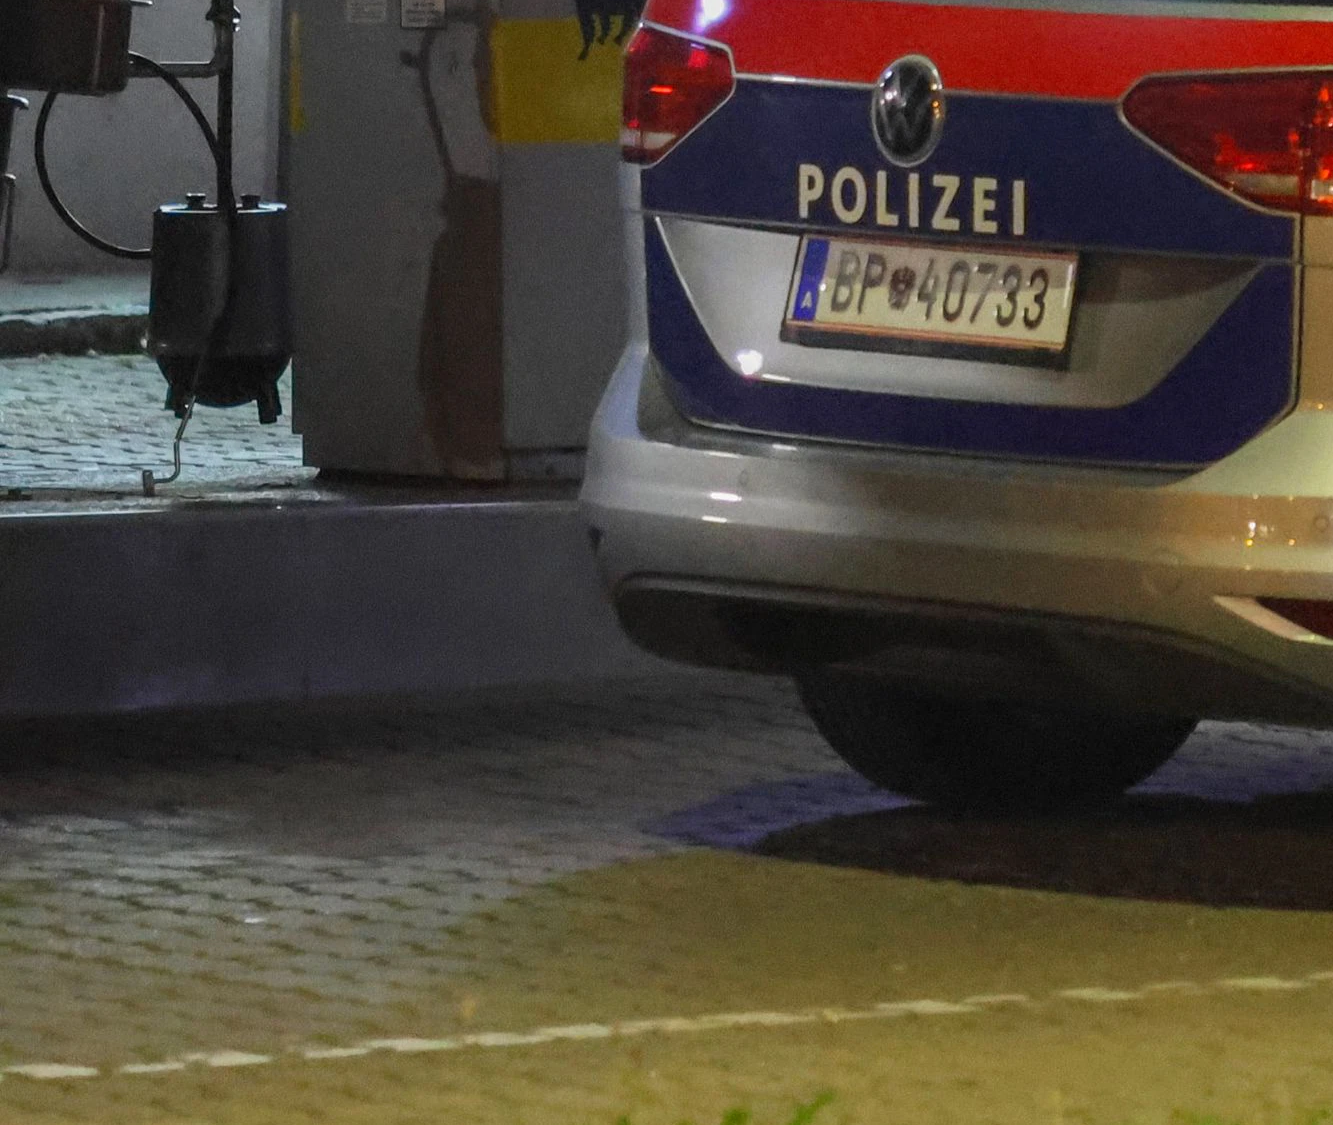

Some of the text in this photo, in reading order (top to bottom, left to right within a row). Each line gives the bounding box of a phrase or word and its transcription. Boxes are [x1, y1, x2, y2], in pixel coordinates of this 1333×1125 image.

[799, 164, 1026, 236] POLIZEI
[831, 250, 1049, 330] BP 40733
